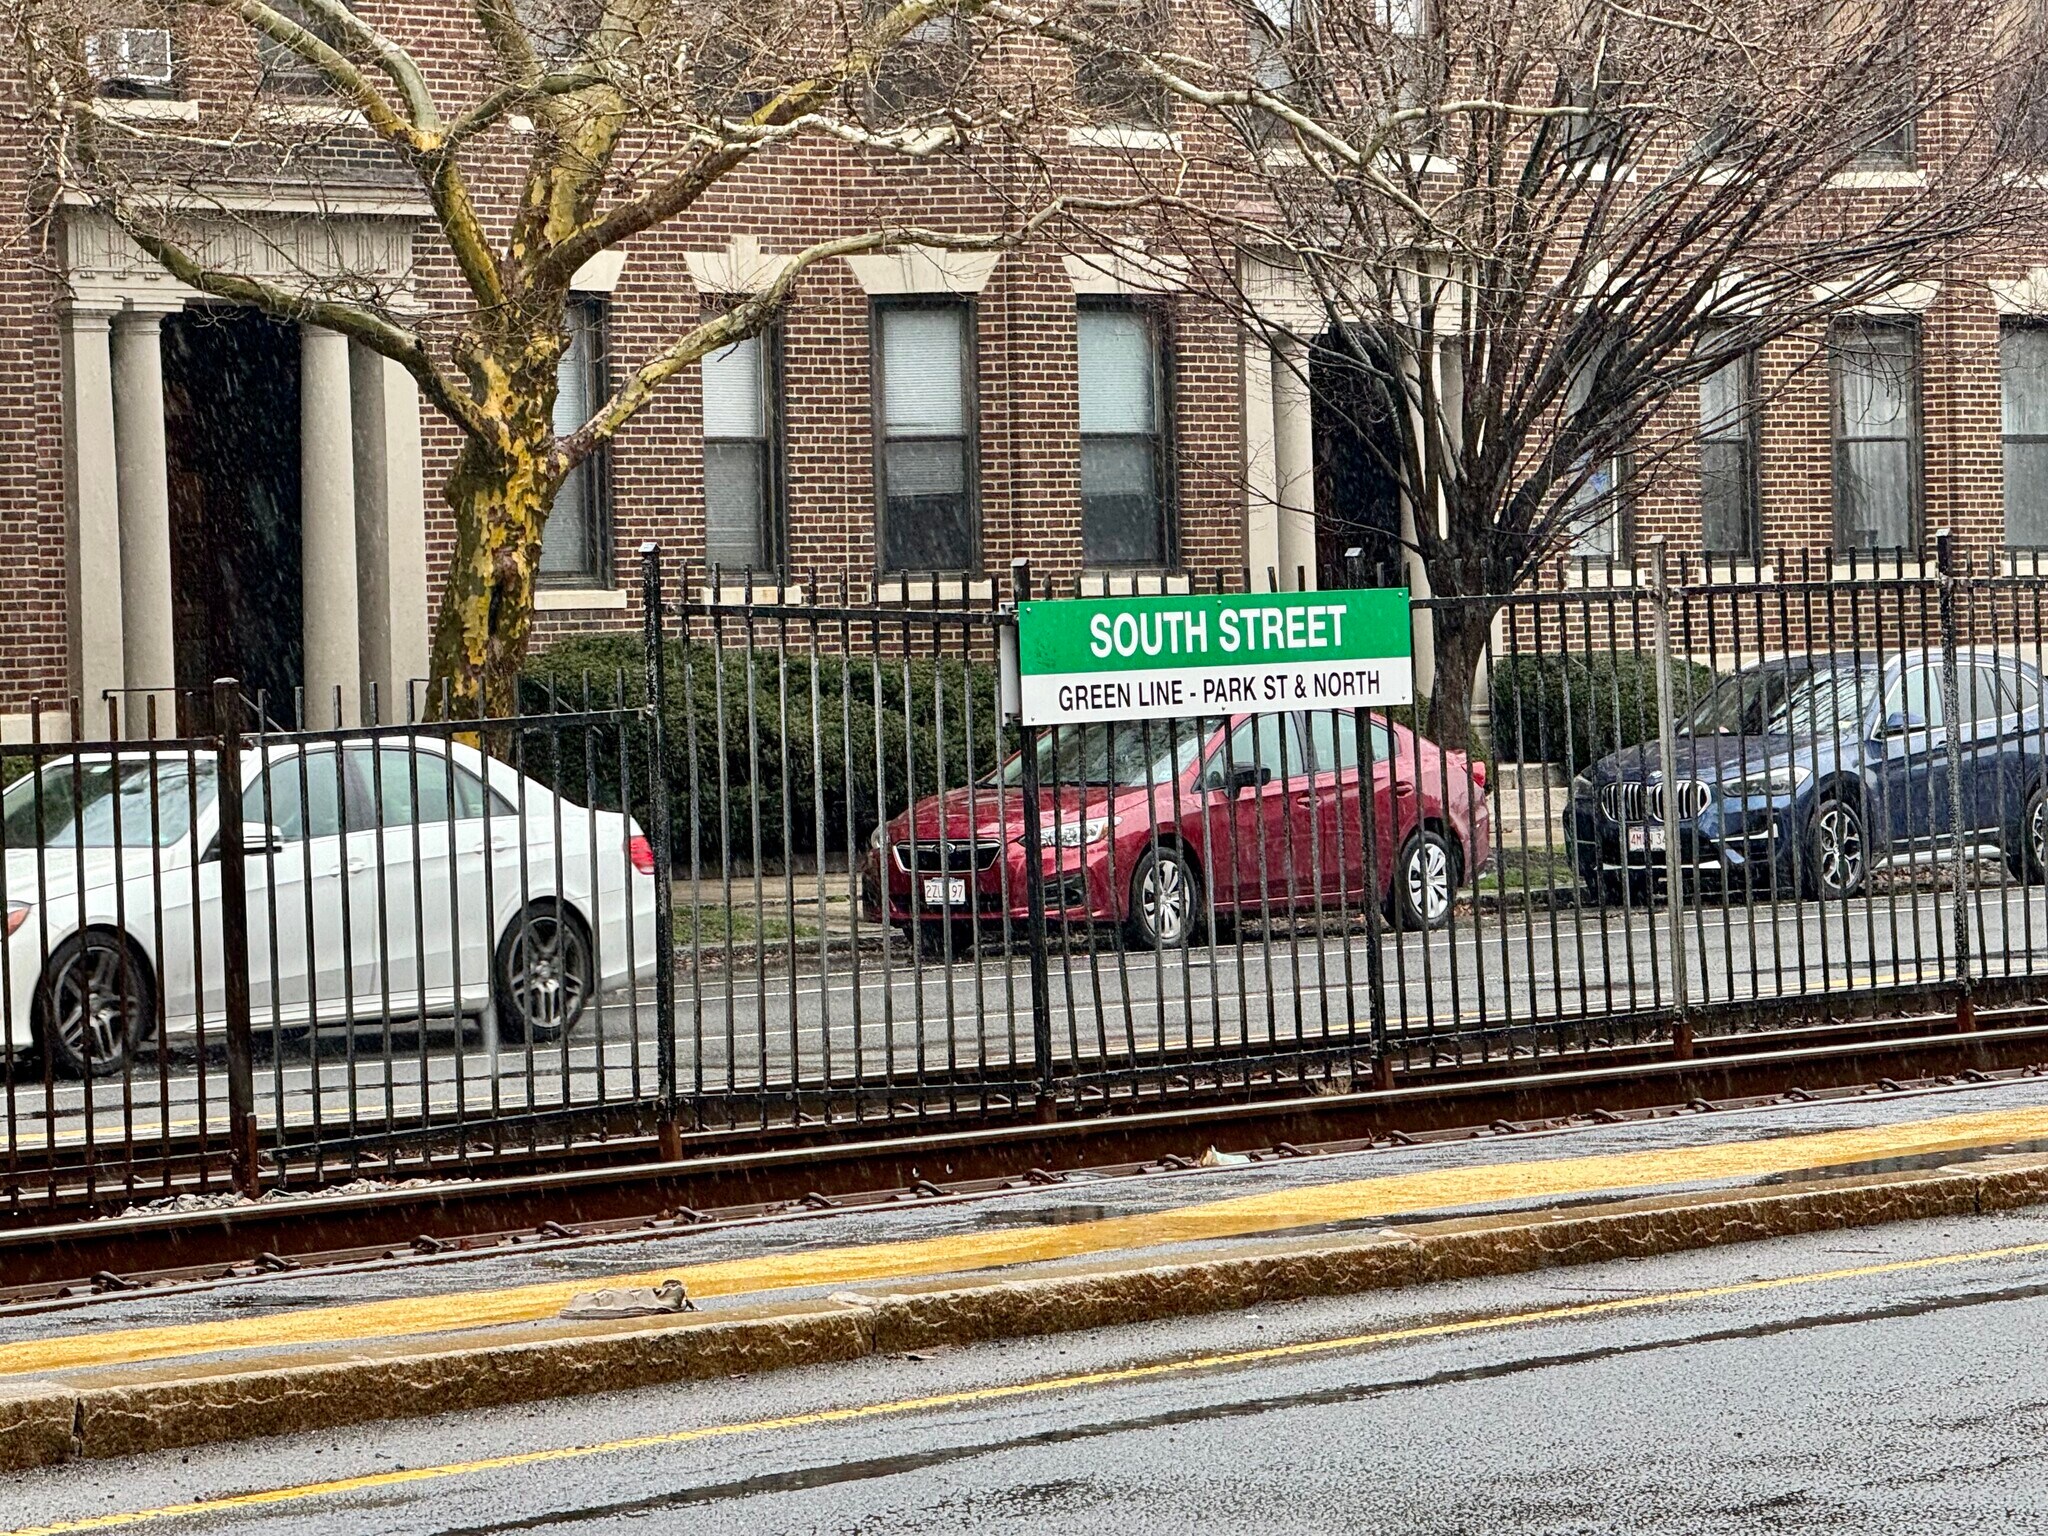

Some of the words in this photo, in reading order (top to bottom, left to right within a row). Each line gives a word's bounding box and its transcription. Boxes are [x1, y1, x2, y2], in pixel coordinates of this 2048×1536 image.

[1090, 611, 1208, 658] SOUTH
[1220, 605, 1347, 652] STREET
[1059, 683, 1131, 711] GREEN
[1138, 680, 1184, 707] LINE
[1203, 676, 1257, 703] PARK
[1264, 675, 1288, 700] ST
[1294, 674, 1307, 698] &
[1314, 671, 1380, 697] NORTH
[951, 884, 963, 898] 97
